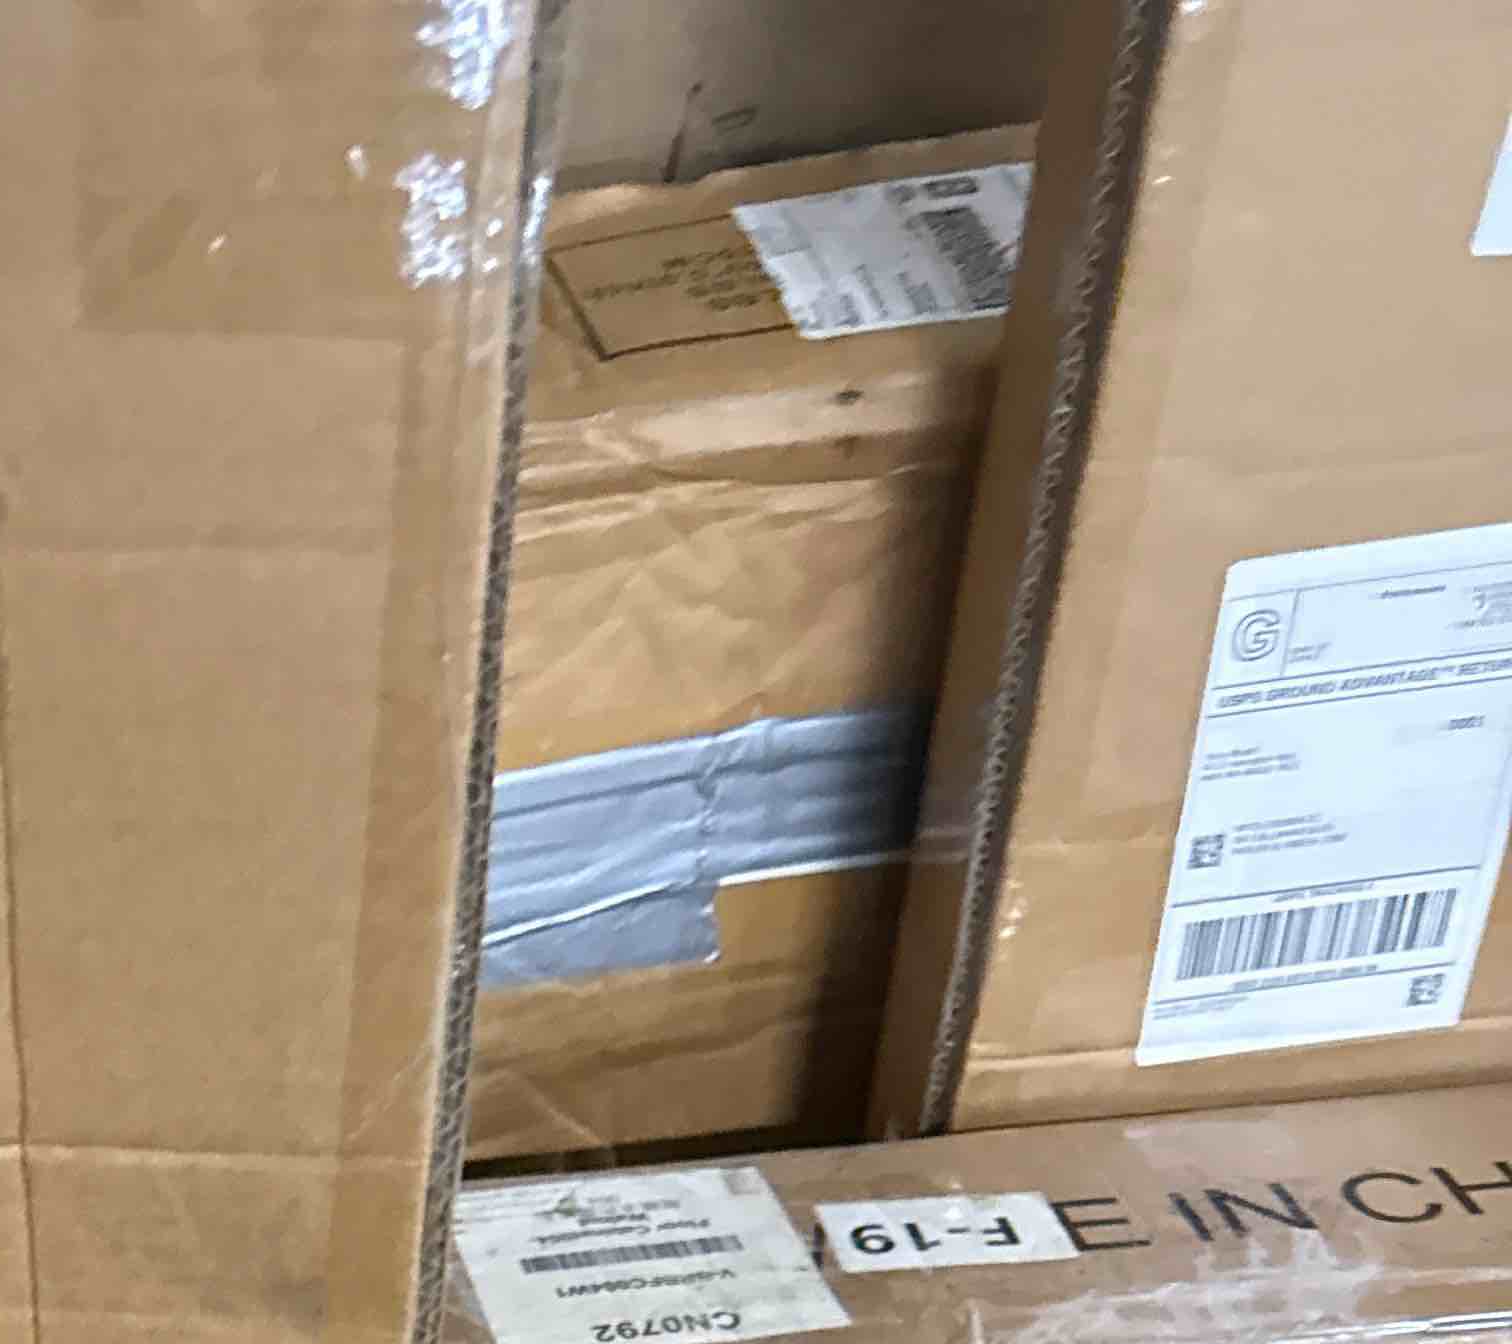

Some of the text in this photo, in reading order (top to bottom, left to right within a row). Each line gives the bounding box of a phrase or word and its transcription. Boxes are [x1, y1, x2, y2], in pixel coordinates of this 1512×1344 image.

[1231, 608, 1281, 662] G
[1167, 1181, 1320, 1243] IN
[849, 1216, 1022, 1256] F-19
[593, 1310, 742, 1343] CN0792
